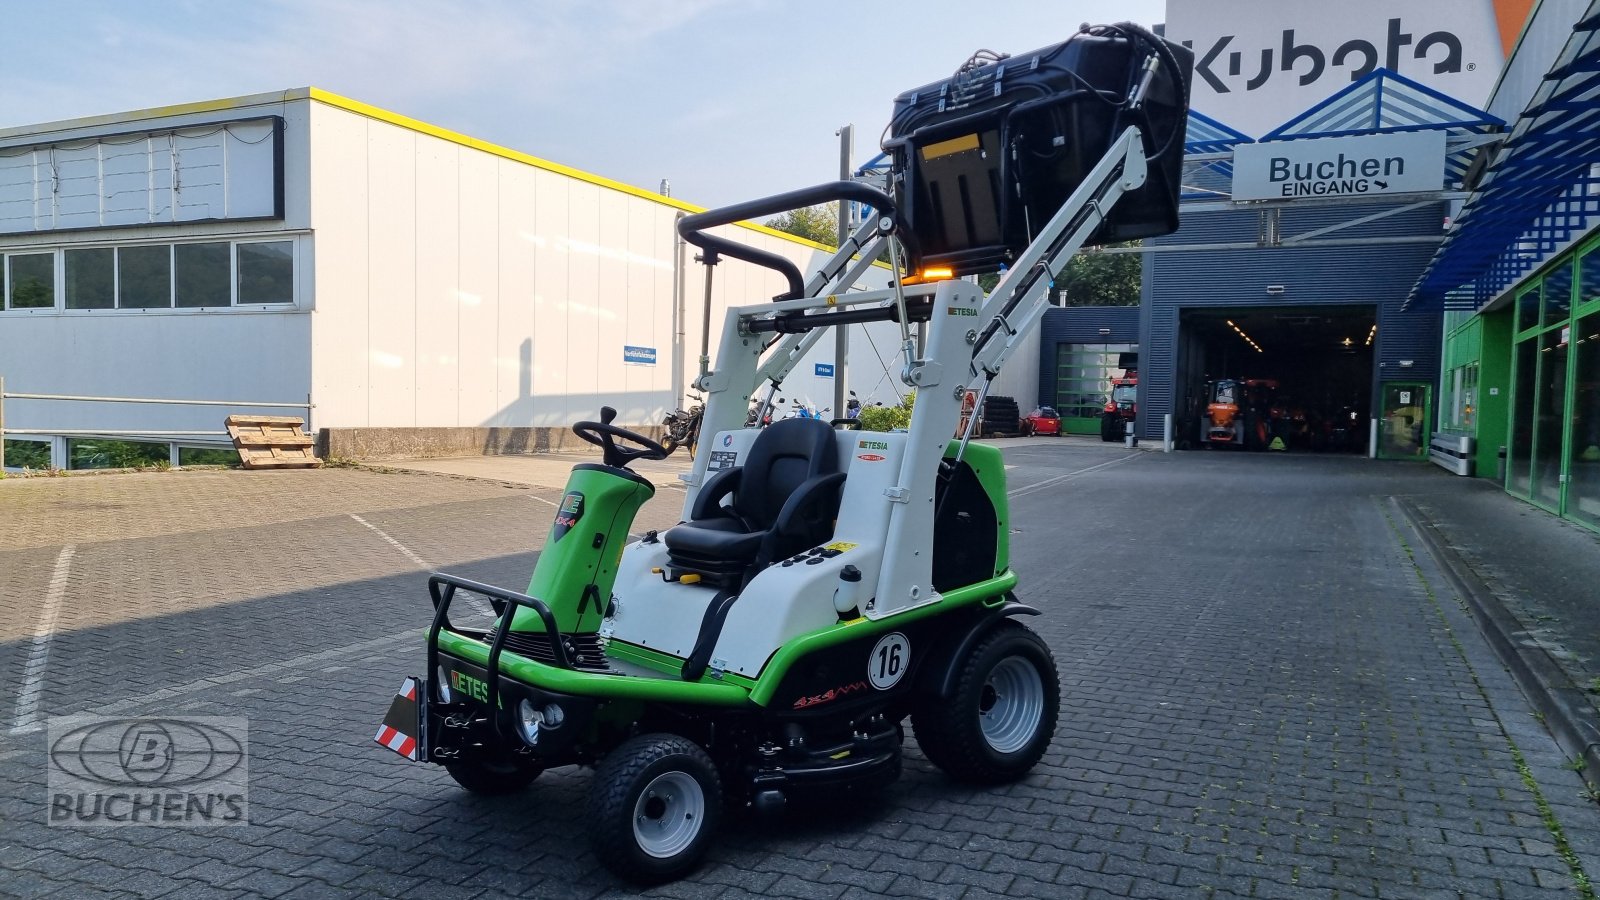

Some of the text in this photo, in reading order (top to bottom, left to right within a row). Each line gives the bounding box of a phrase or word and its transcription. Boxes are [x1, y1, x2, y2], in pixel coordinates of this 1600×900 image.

[1269, 153, 1405, 183] Buchen
[1281, 178, 1370, 197] EINGANG
[948, 306, 978, 317] ETESIA
[859, 440, 888, 450] ETESIA
[879, 643, 902, 679] 16
[451, 669, 503, 710] ETES
